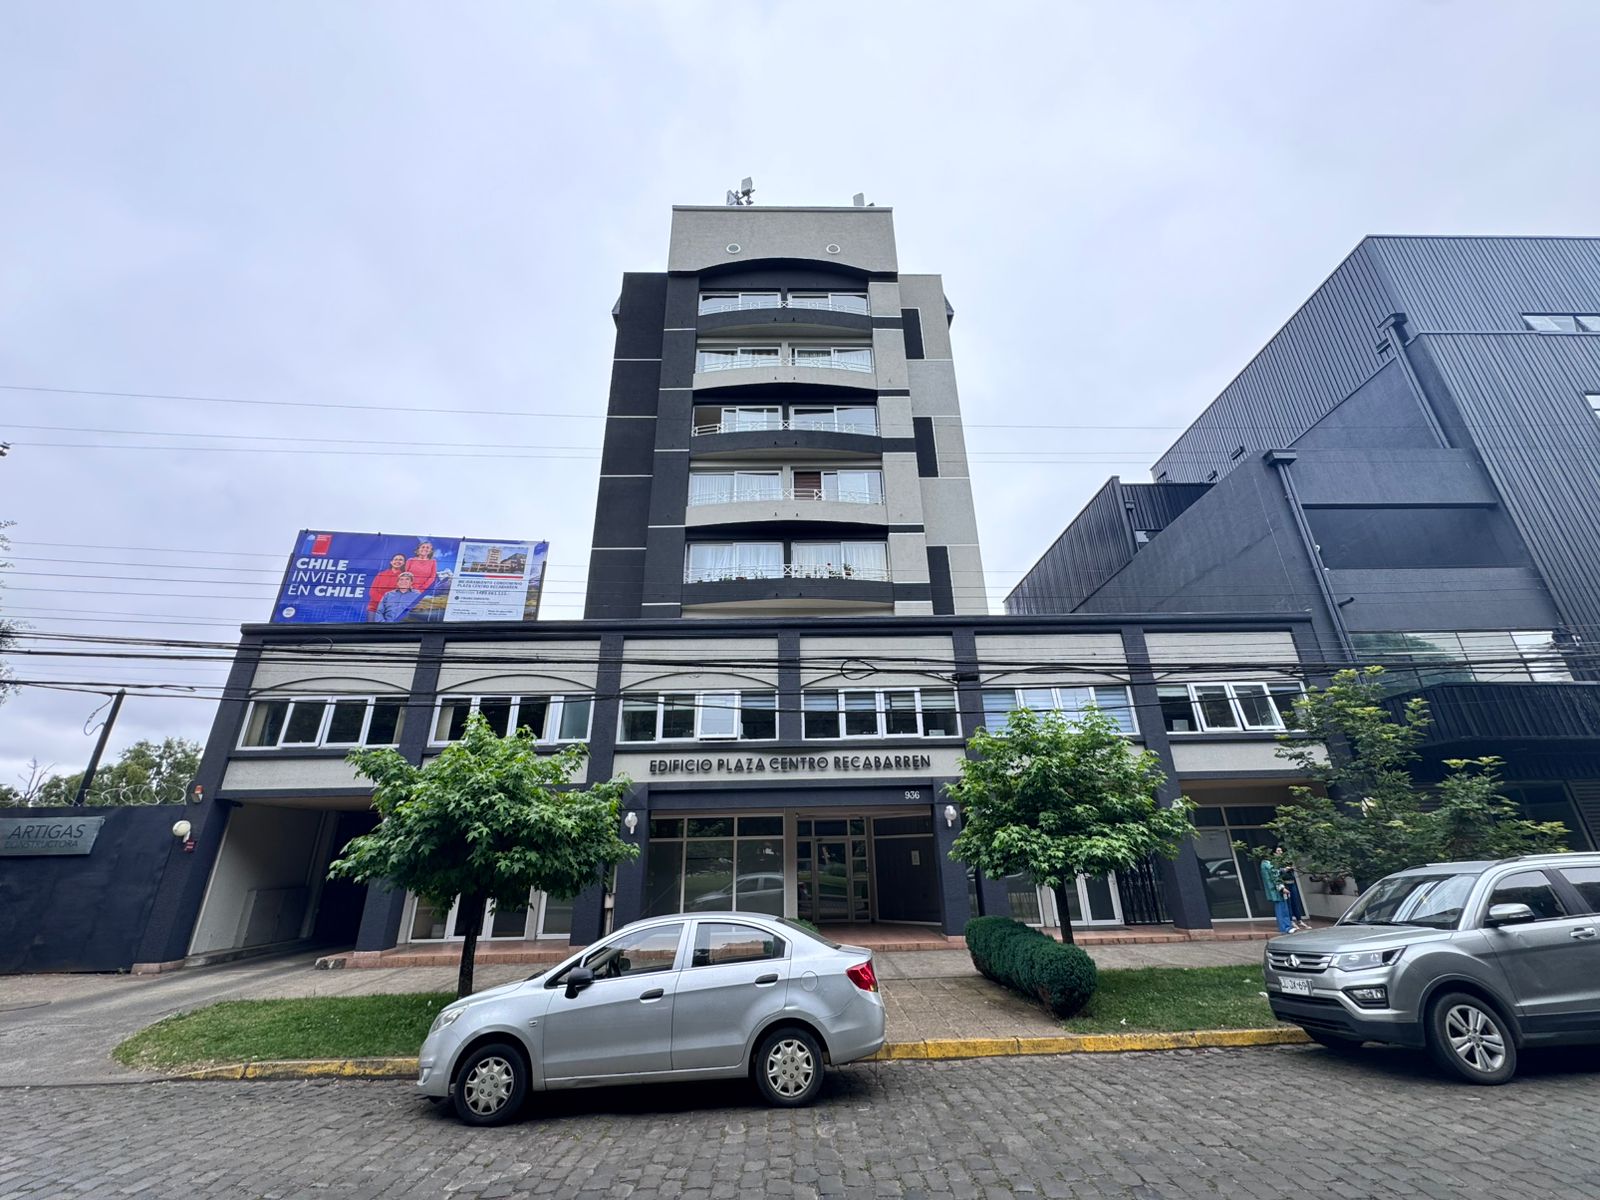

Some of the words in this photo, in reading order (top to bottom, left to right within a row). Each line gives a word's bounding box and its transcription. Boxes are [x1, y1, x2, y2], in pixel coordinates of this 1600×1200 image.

[296, 557, 349, 570] CHILE
[292, 570, 367, 585] INVIERTE
[288, 583, 310, 596] EN
[314, 585, 365, 598] CHILE
[649, 759, 713, 772] EDIFICIO
[717, 758, 766, 772] PLAZA
[769, 756, 829, 772] CENTRO
[833, 755, 931, 771] RECABARREN
[904, 790, 920, 799] 936
[8, 824, 86, 839] ARTIGAS
[4, 840, 78, 849] CONSTRUCTORA
